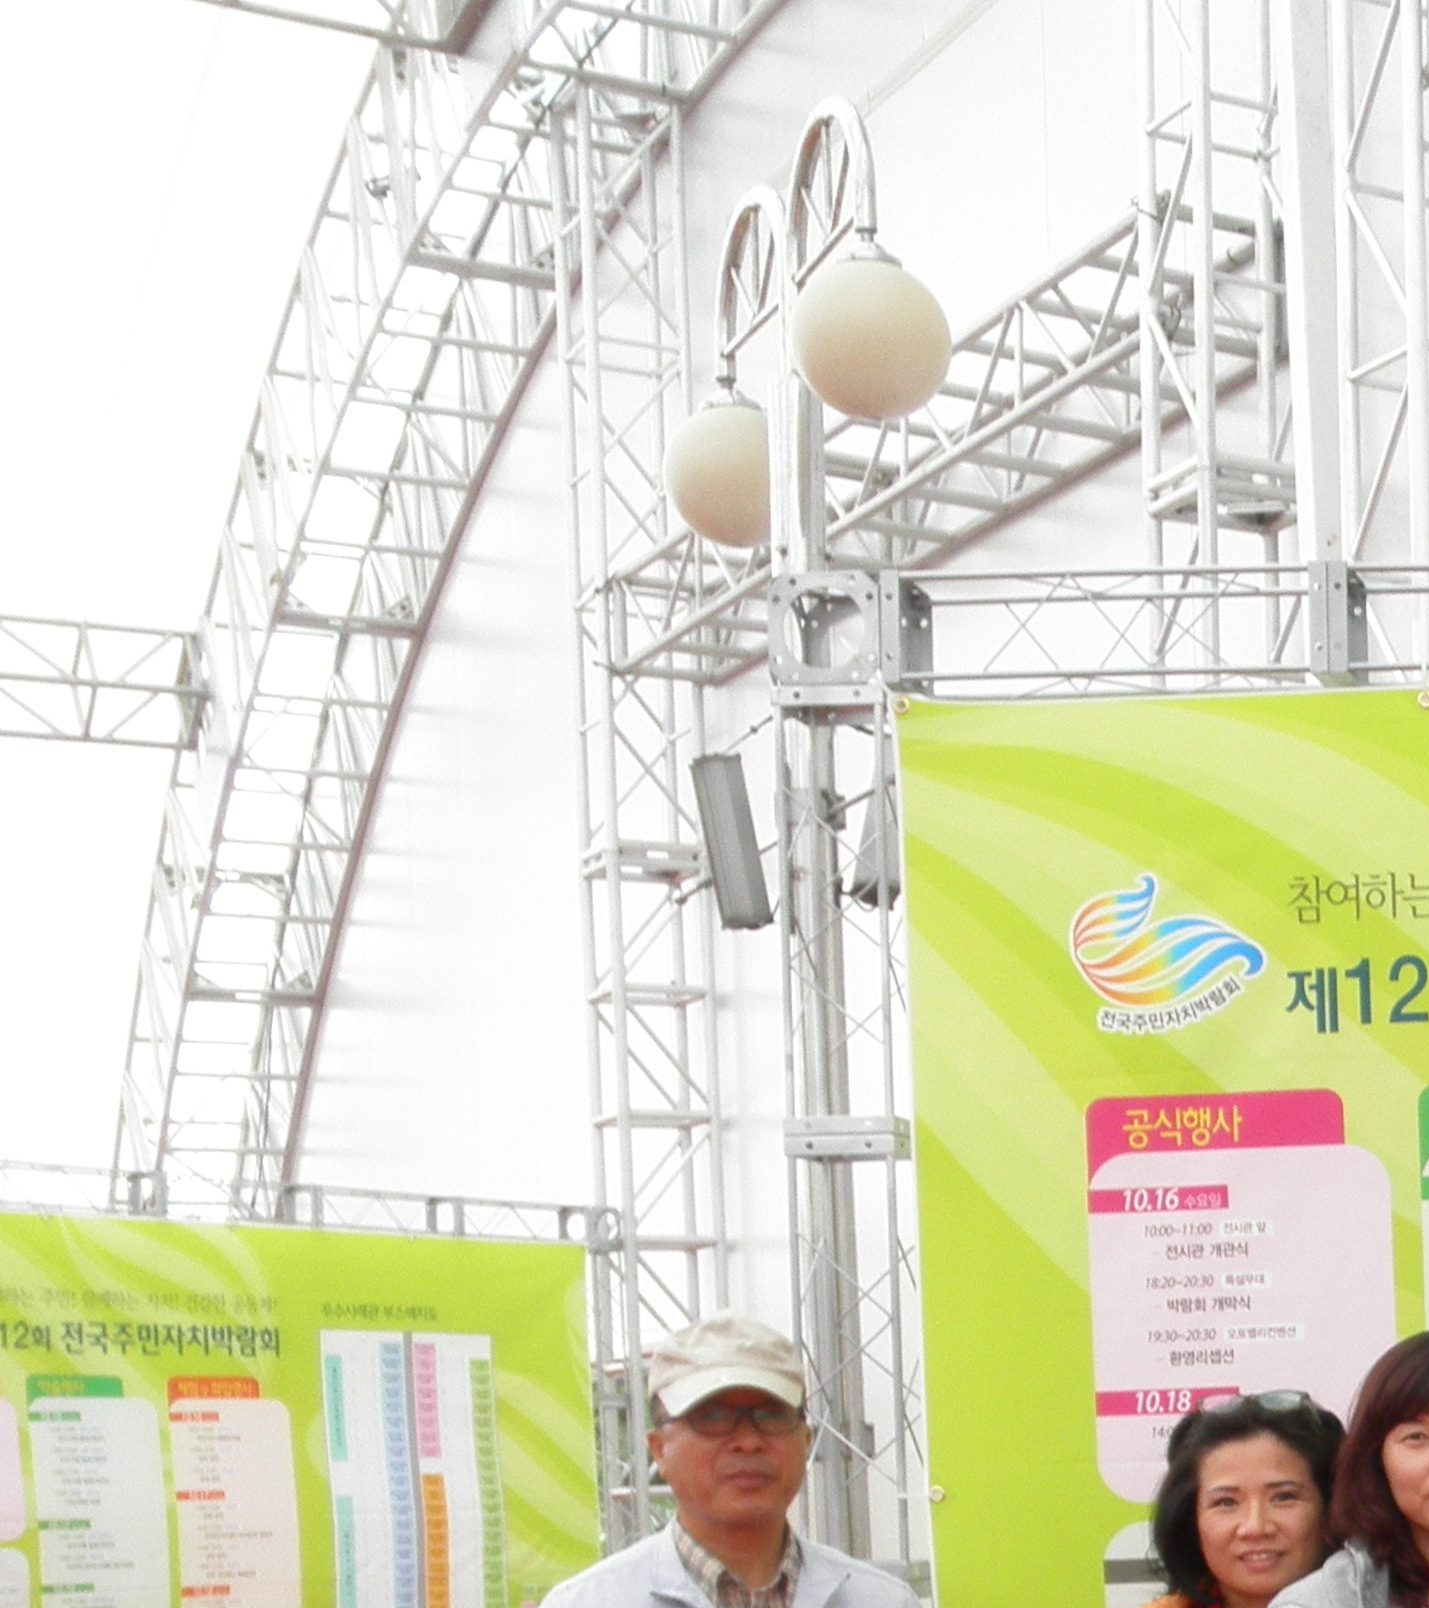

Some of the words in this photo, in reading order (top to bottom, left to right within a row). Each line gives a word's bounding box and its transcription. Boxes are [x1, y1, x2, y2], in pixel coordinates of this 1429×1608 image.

[1100, 976, 1241, 1031] 전국주민자치박람회
[1123, 1105, 1243, 1149] 공식행사
[1123, 1188, 1179, 1212] 10.16
[1184, 1193, 1221, 1209] 수요일
[1166, 1244, 1204, 1260] 전시관
[1210, 1242, 1249, 1257] 개관식
[1167, 1298, 1206, 1313] 박람회
[1212, 1296, 1251, 1311] 개막식
[61, 1321, 280, 1357] 전국주민자치박람회
[1170, 1350, 1235, 1366] 환영리셉션
[1135, 1391, 1192, 1413] 10.18
